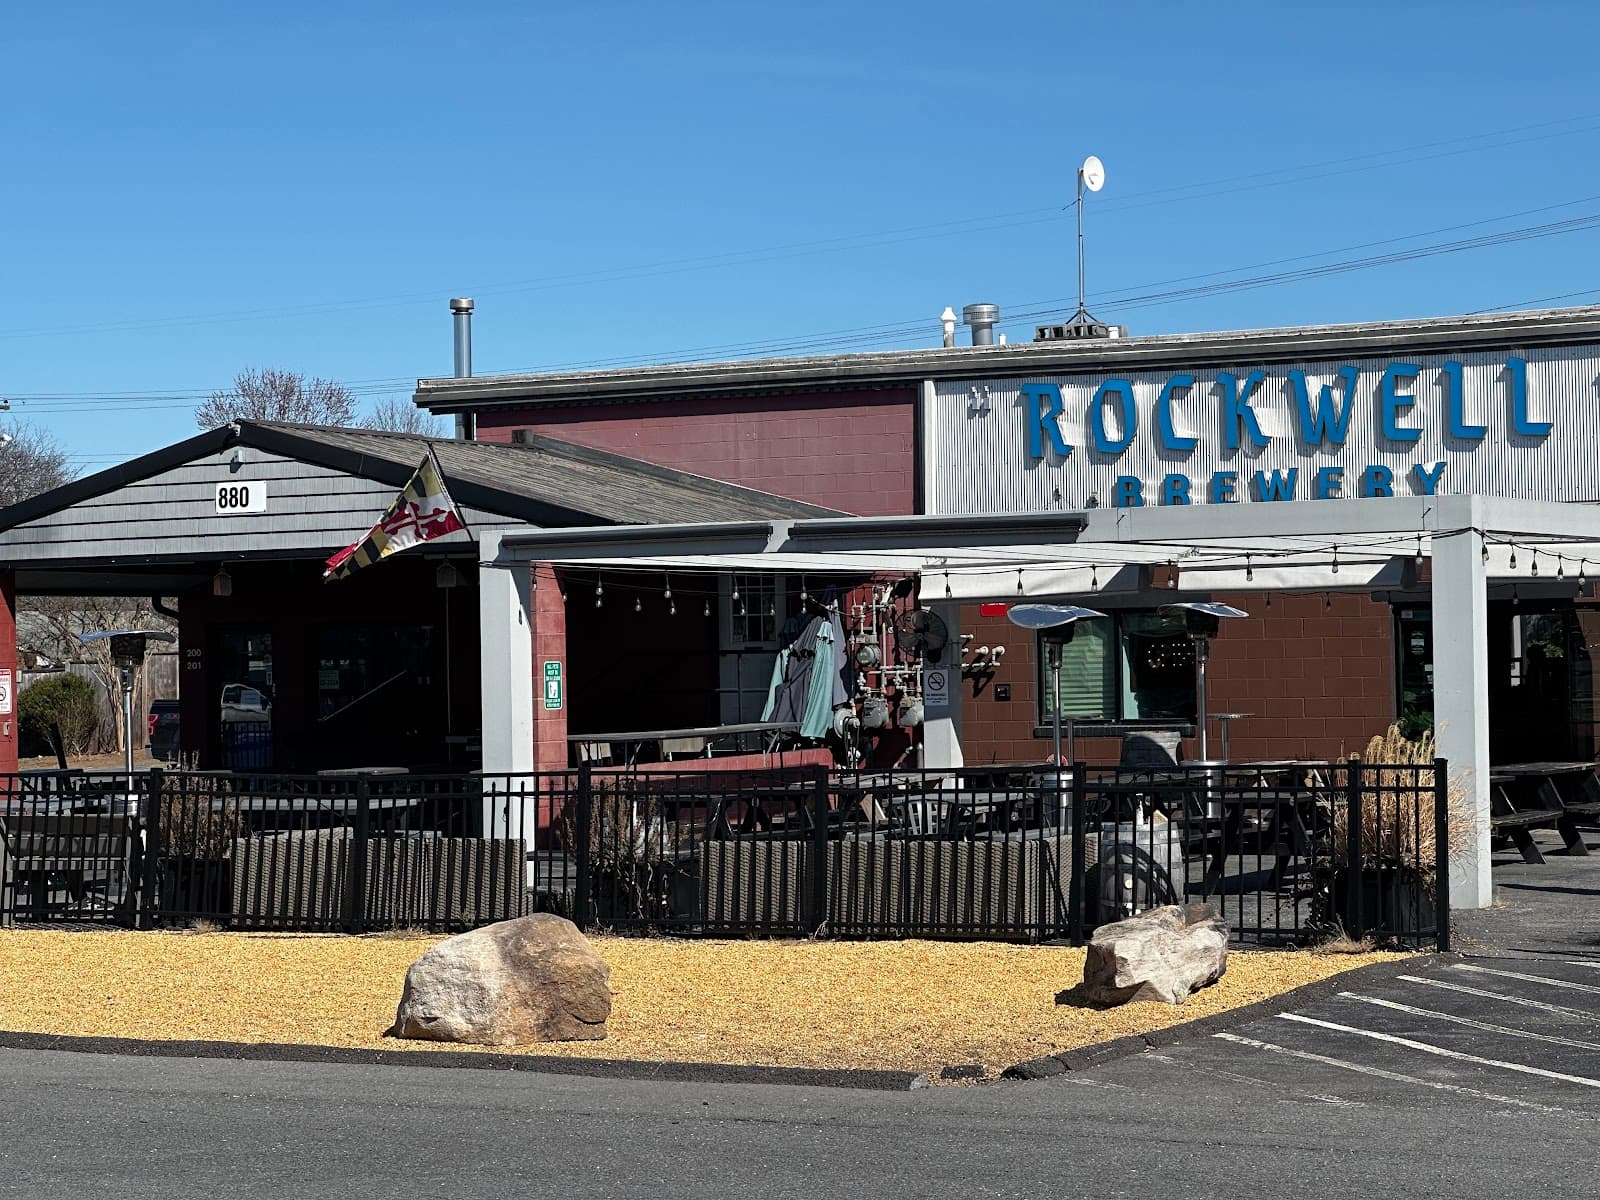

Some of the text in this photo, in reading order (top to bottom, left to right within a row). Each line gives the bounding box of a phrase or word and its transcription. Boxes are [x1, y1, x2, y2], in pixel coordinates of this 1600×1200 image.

[1020, 356, 1553, 458] ROCKWELL
[1117, 461, 1447, 508] BREWERY
[218, 486, 249, 509] 880
[186, 649, 202, 657] 200
[186, 661, 202, 670] 201
